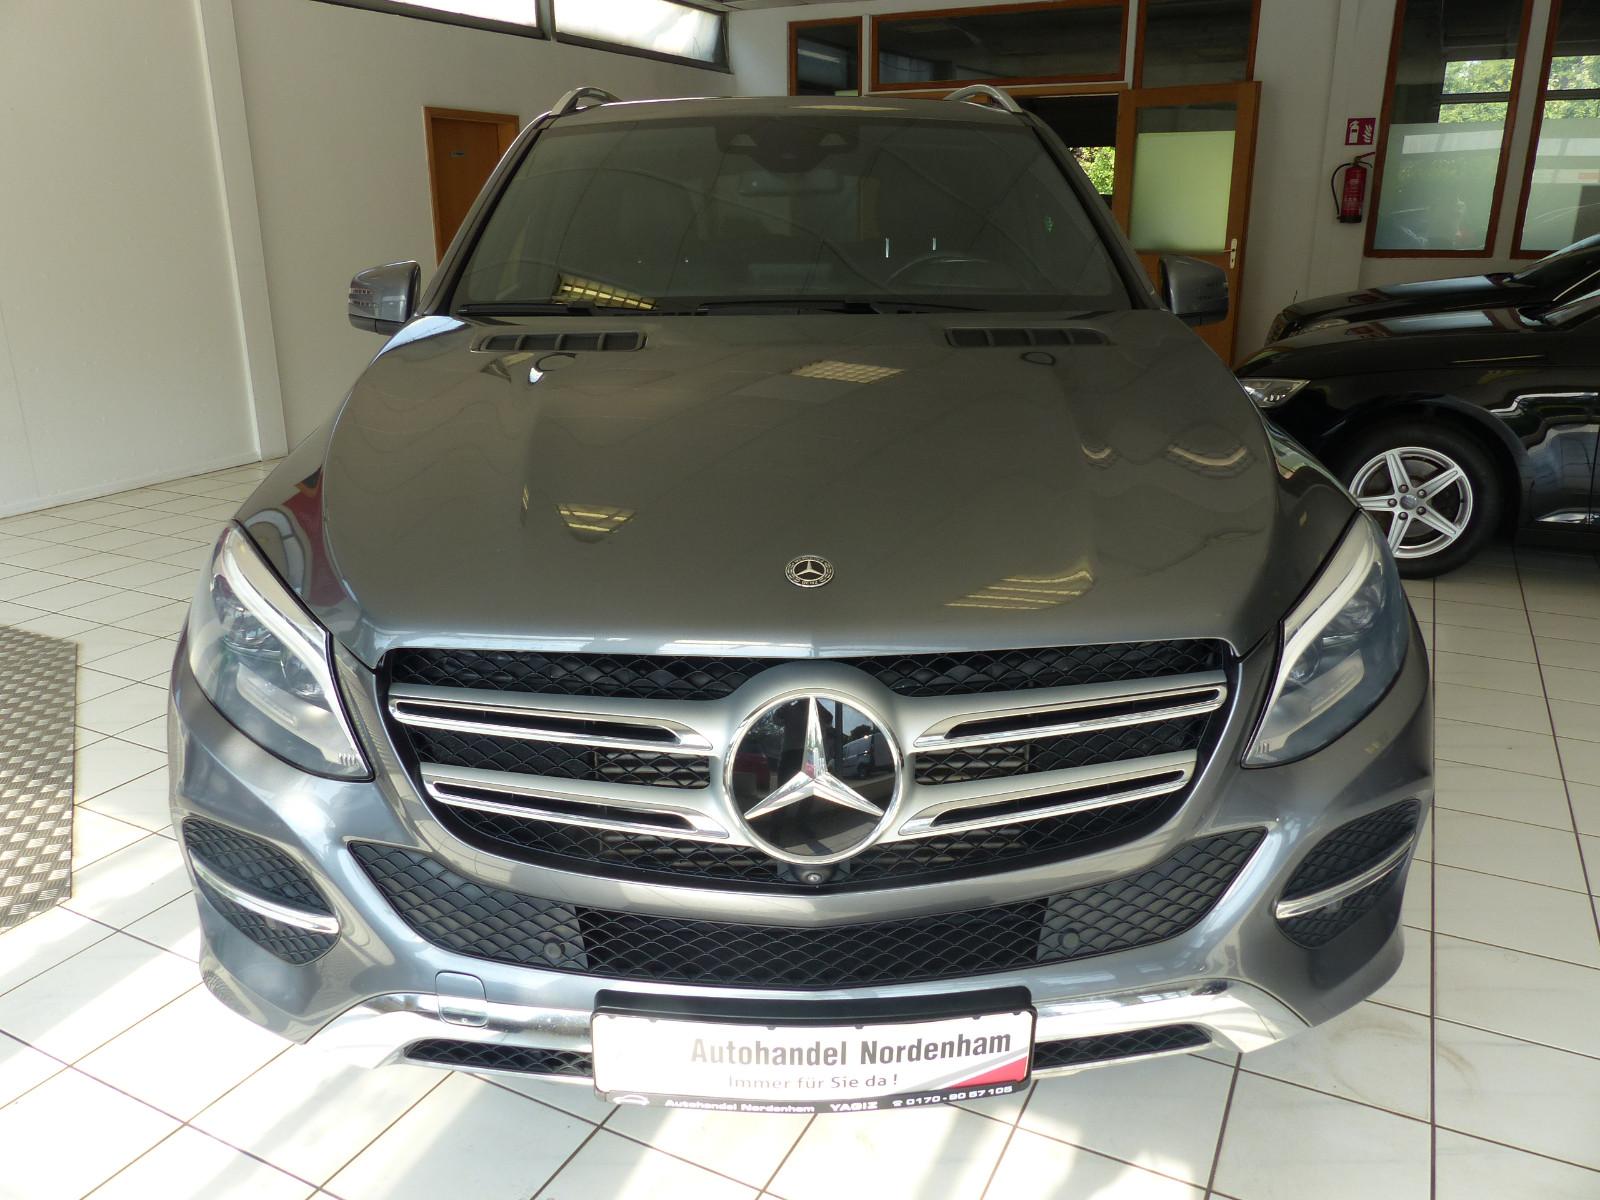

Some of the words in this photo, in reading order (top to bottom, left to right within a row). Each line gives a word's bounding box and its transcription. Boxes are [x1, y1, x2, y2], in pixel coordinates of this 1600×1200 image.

[691, 1038, 847, 1066] Autohandel
[860, 1033, 1011, 1065] Nordenham
[728, 1074, 790, 1089] Immer
[798, 1076, 824, 1089] für
[831, 1076, 859, 1089] Sie
[865, 1075, 887, 1088] da
[665, 1100, 737, 1111] Autohandel
[741, 1103, 815, 1113] Nordenham
[906, 1095, 941, 1107] 0170
